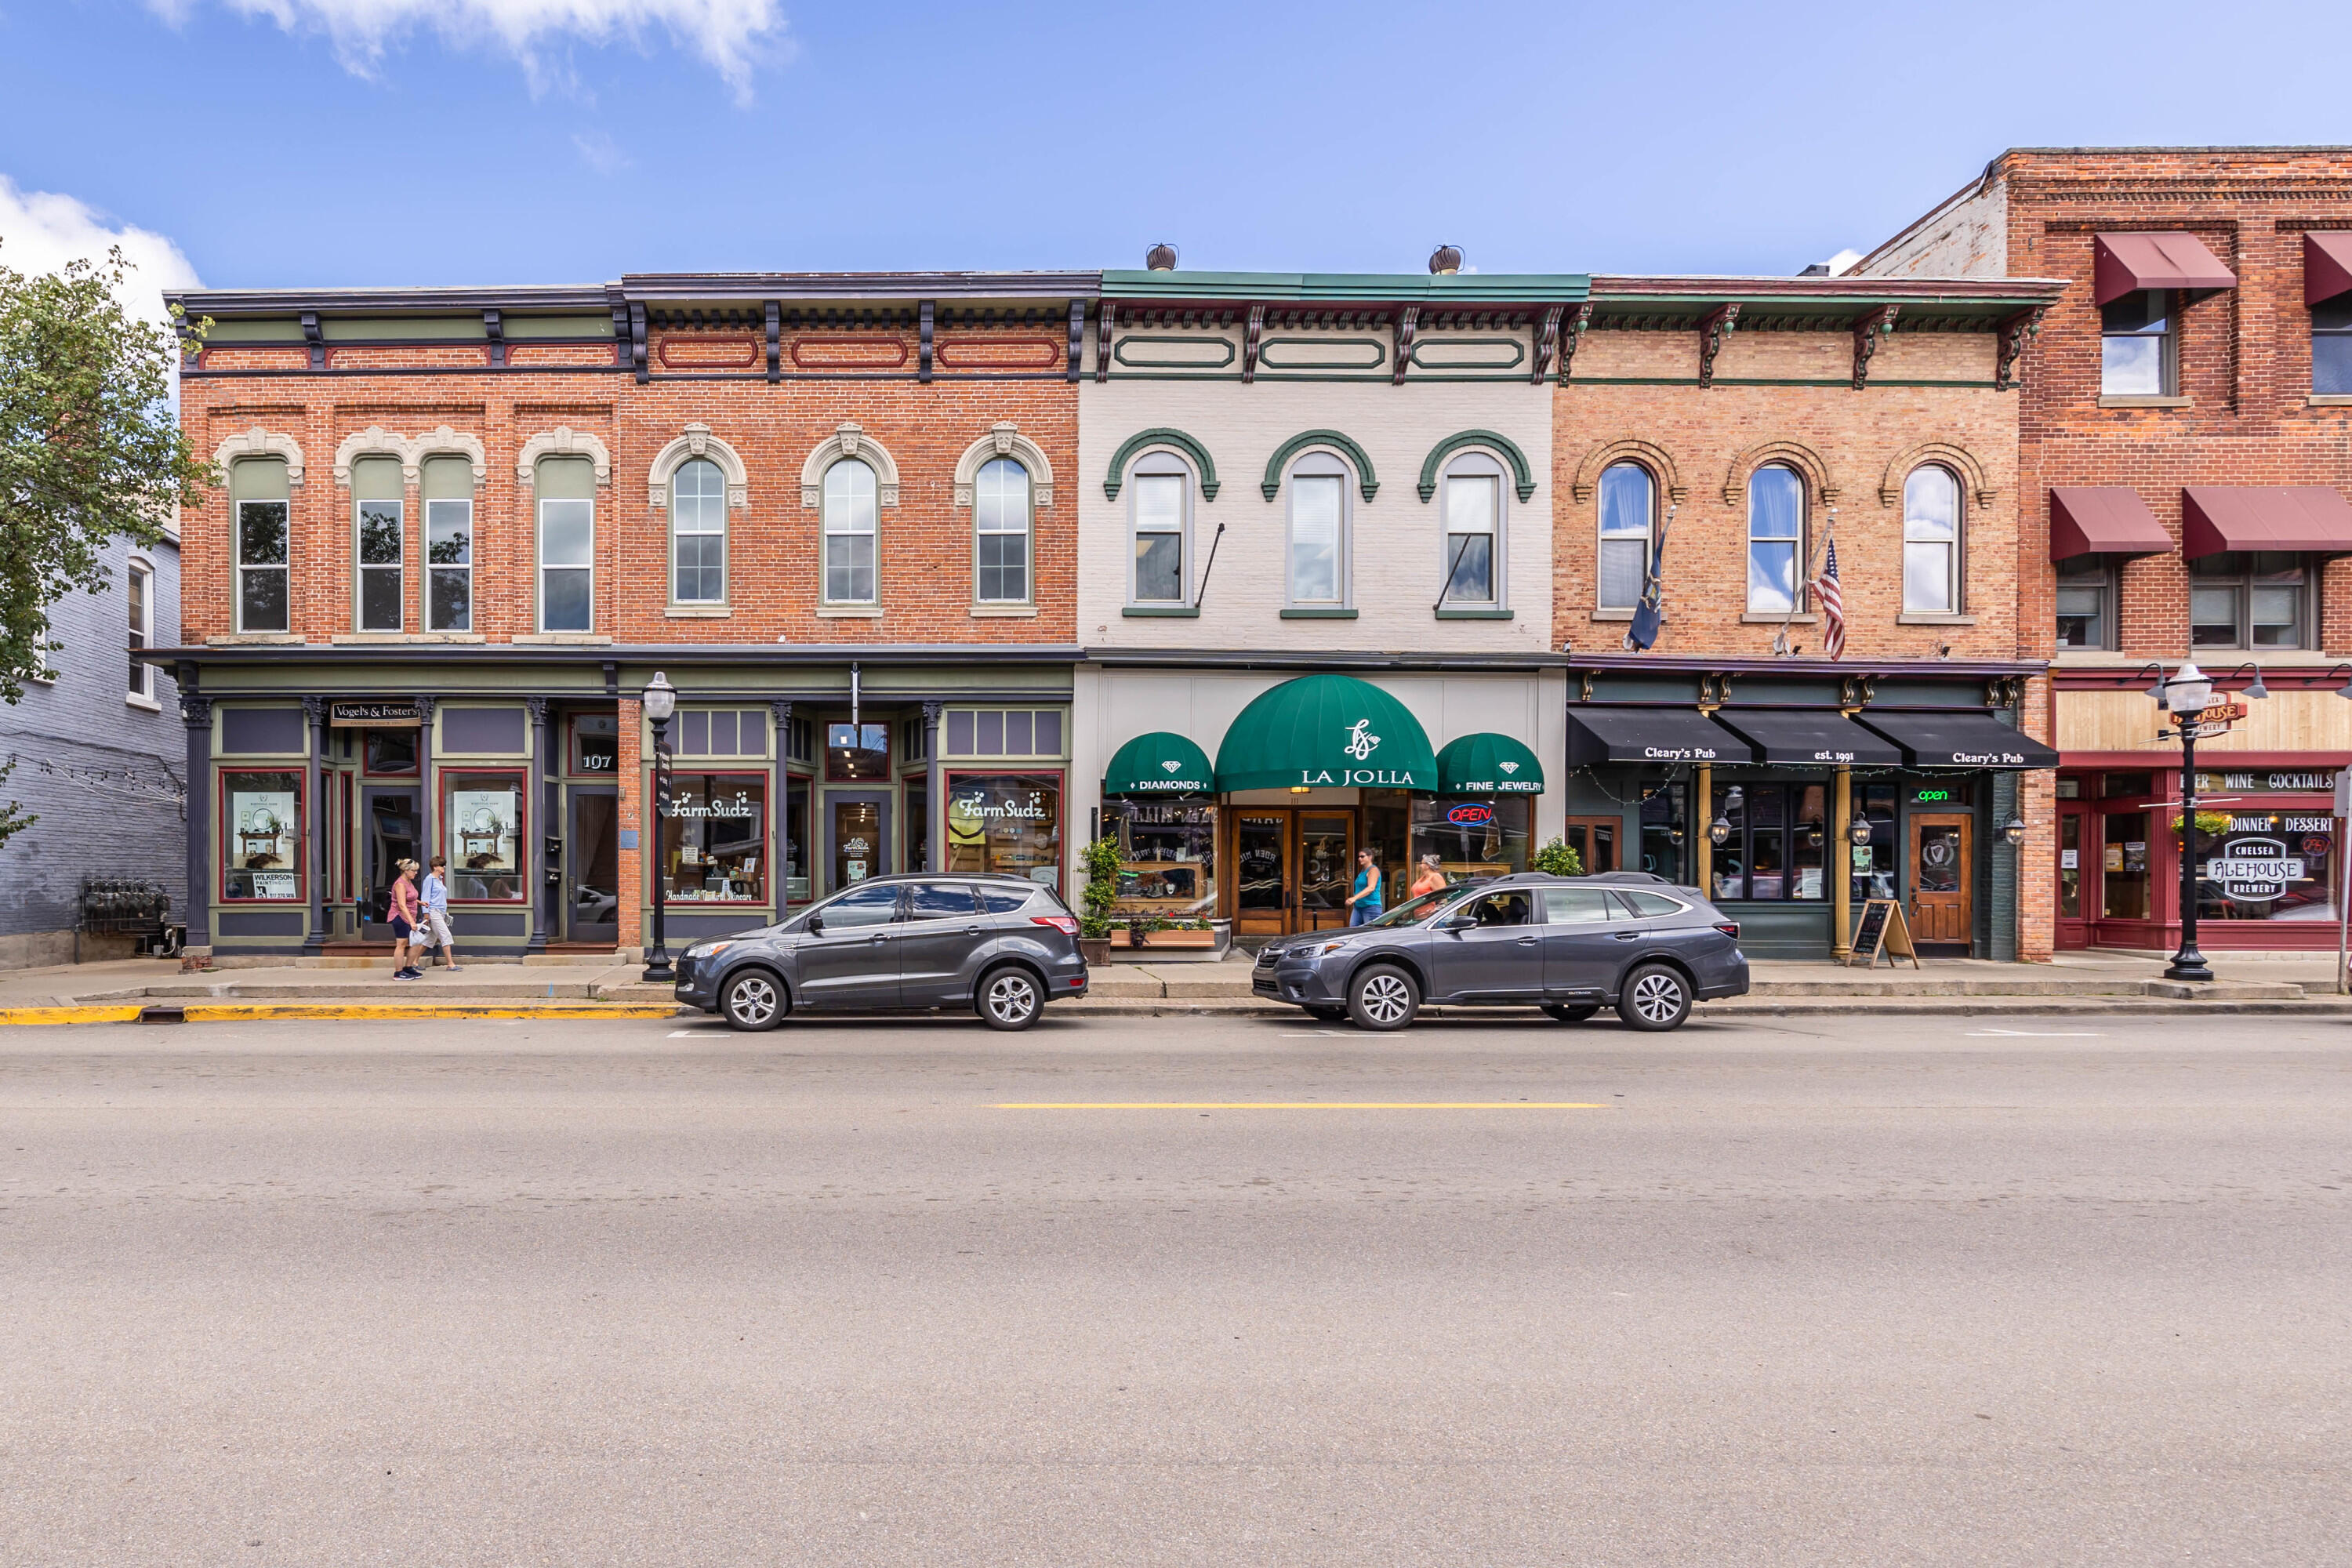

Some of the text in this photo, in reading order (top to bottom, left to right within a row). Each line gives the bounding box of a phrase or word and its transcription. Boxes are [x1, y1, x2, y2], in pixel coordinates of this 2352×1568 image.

[336, 706, 417, 717] Vogel's & Foster's
[1645, 746, 1716, 760] Cleary's Pub
[1814, 750, 1854, 762] est. 1991
[1952, 752, 2024, 764] Cleary's Pub
[583, 753, 612, 769] 107
[1139, 780, 1200, 789] DIAMONDS
[1301, 770, 1414, 786] LA JOLLA
[2225, 773, 2255, 789] WINE
[2268, 773, 2334, 789] COCKTAILS
[1466, 782, 1541, 790] FINE JEWELRY
[1918, 791, 1947, 802] open
[959, 799, 1046, 818] FarmSudz
[1449, 808, 1492, 822] OPEN
[2230, 818, 2334, 832] DINNER DESSERT
[2235, 847, 2274, 855] CHELSEA
[2214, 862, 2297, 881] ALEHOUSE
[2233, 884, 2276, 893] BREWERY
